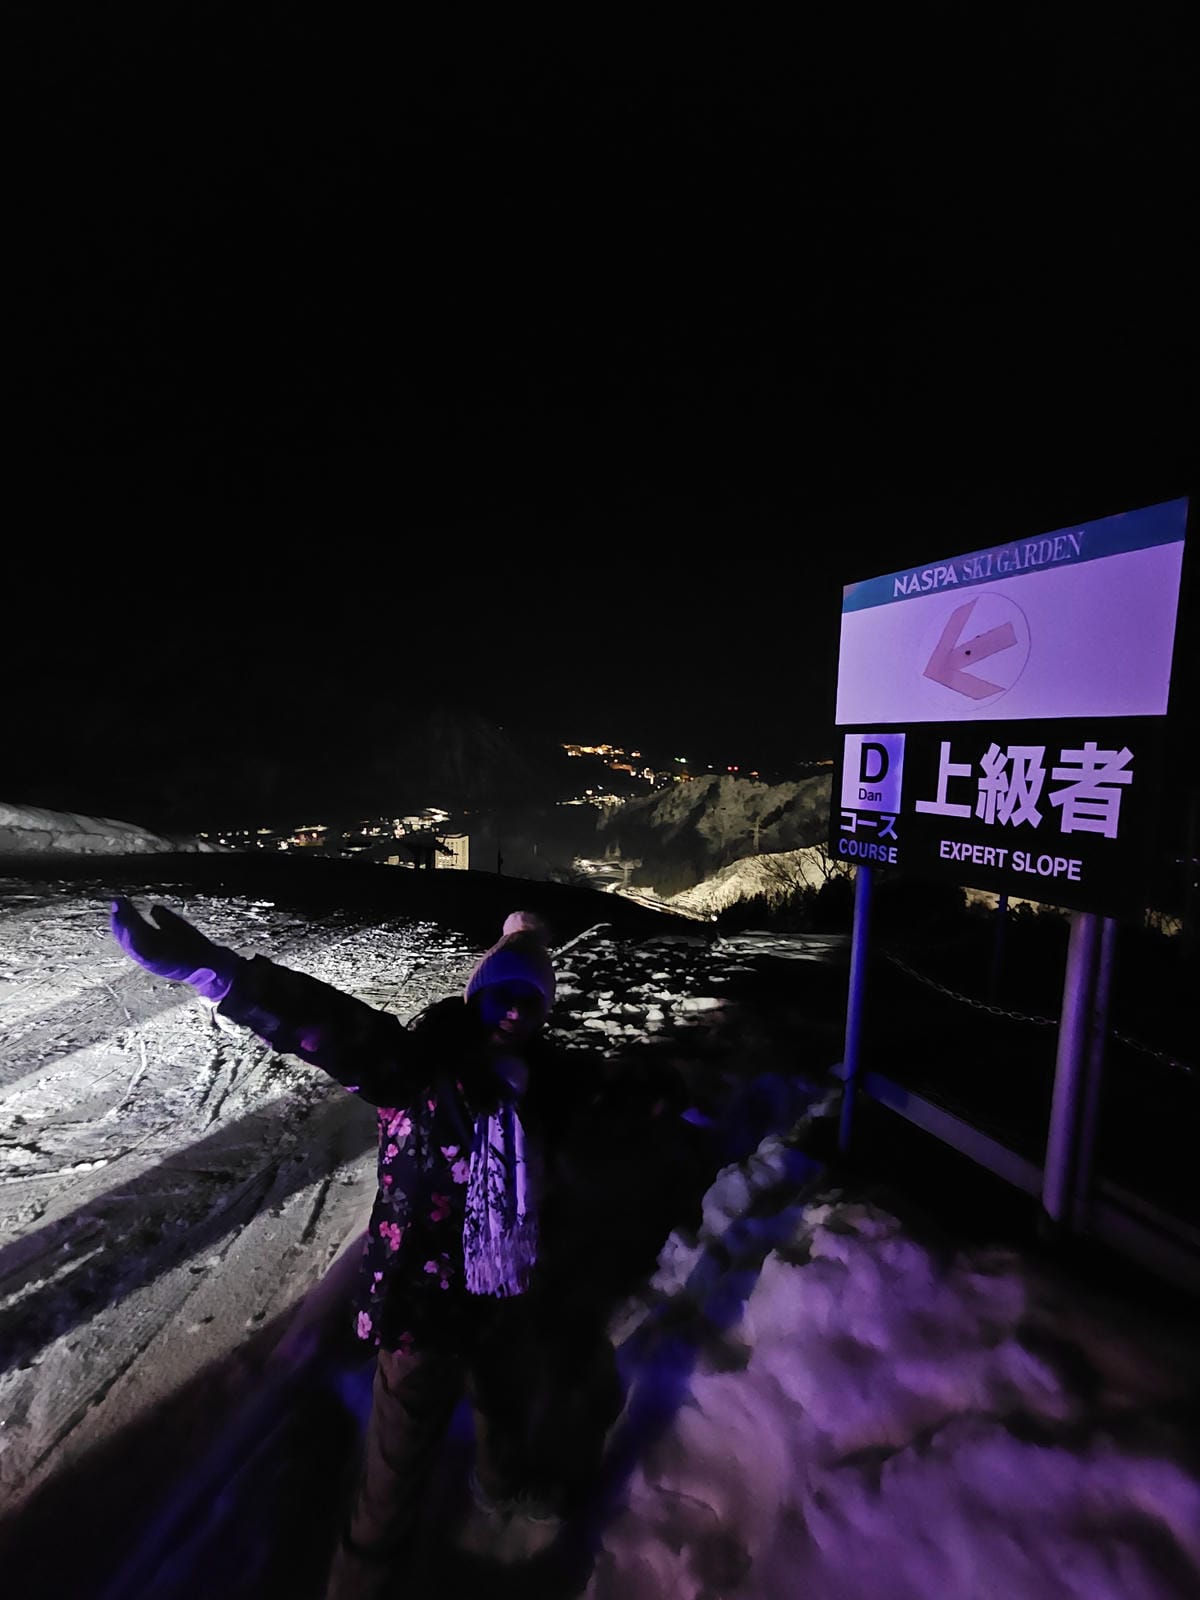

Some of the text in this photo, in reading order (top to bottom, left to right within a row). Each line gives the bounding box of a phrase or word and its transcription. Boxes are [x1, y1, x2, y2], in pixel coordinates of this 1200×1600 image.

[893, 531, 1086, 598] NASPA SKI GARDEN
[859, 742, 889, 784] D
[858, 788, 882, 802] Dan
[915, 741, 1135, 839] 上級者
[840, 811, 898, 840] コース
[839, 838, 898, 864] COURSE
[939, 840, 1082, 881] EXPERT SLOPE
